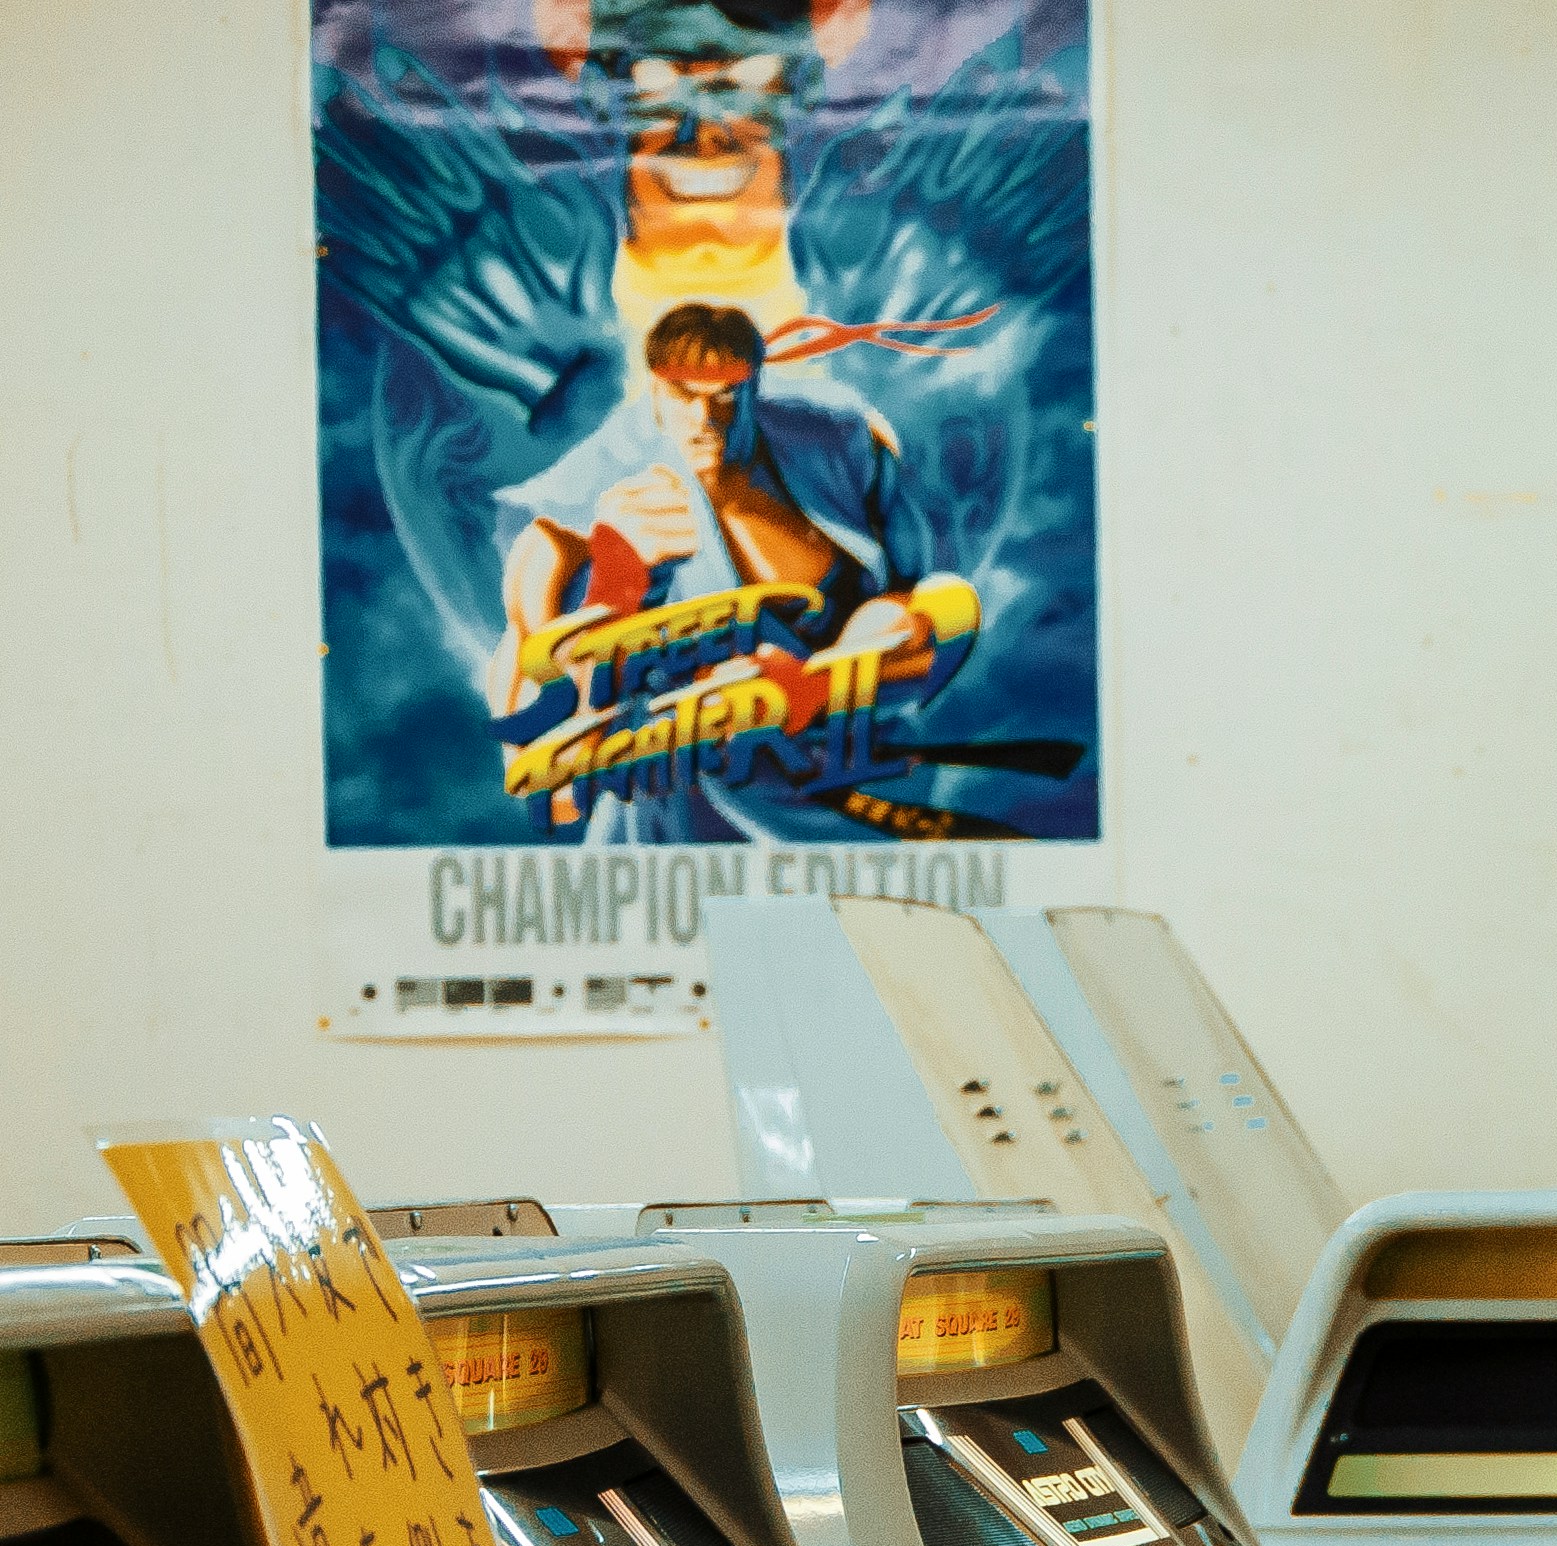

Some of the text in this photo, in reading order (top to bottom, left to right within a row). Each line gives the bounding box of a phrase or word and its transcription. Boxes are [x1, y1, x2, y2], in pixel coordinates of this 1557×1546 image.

[490, 582, 826, 746] STREET
[504, 630, 922, 835] FIGHTER II
[935, 1310, 998, 1337] SQUARE
[442, 1352, 521, 1388] SQUARE
[1022, 1472, 1089, 1507] ASTRO
